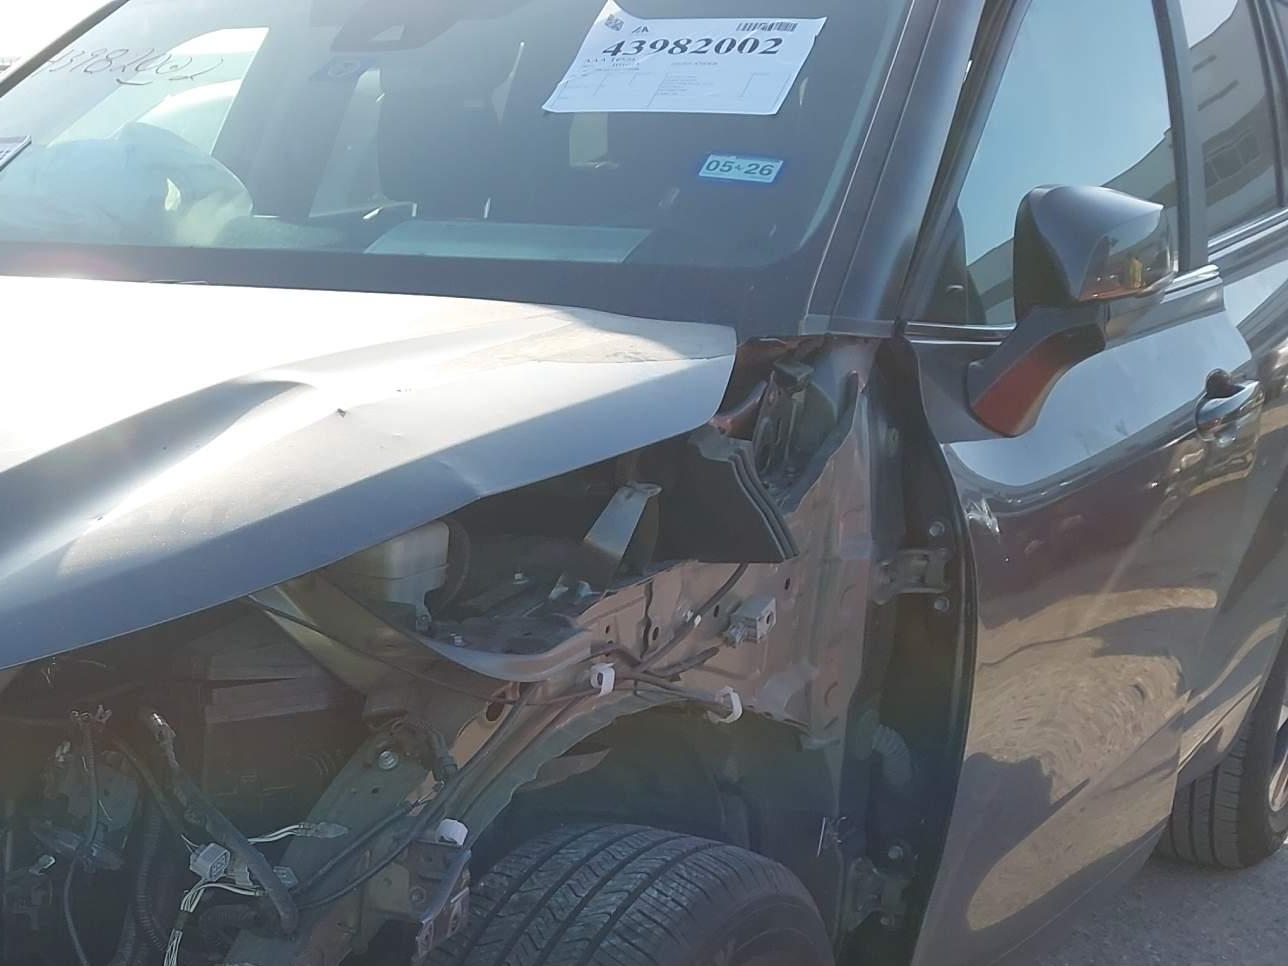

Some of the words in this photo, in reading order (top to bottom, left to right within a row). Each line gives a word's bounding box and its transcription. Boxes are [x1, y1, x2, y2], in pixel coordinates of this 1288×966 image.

[602, 37, 784, 56] 43982002
[705, 159, 734, 173] 05
[744, 162, 775, 176] 26
